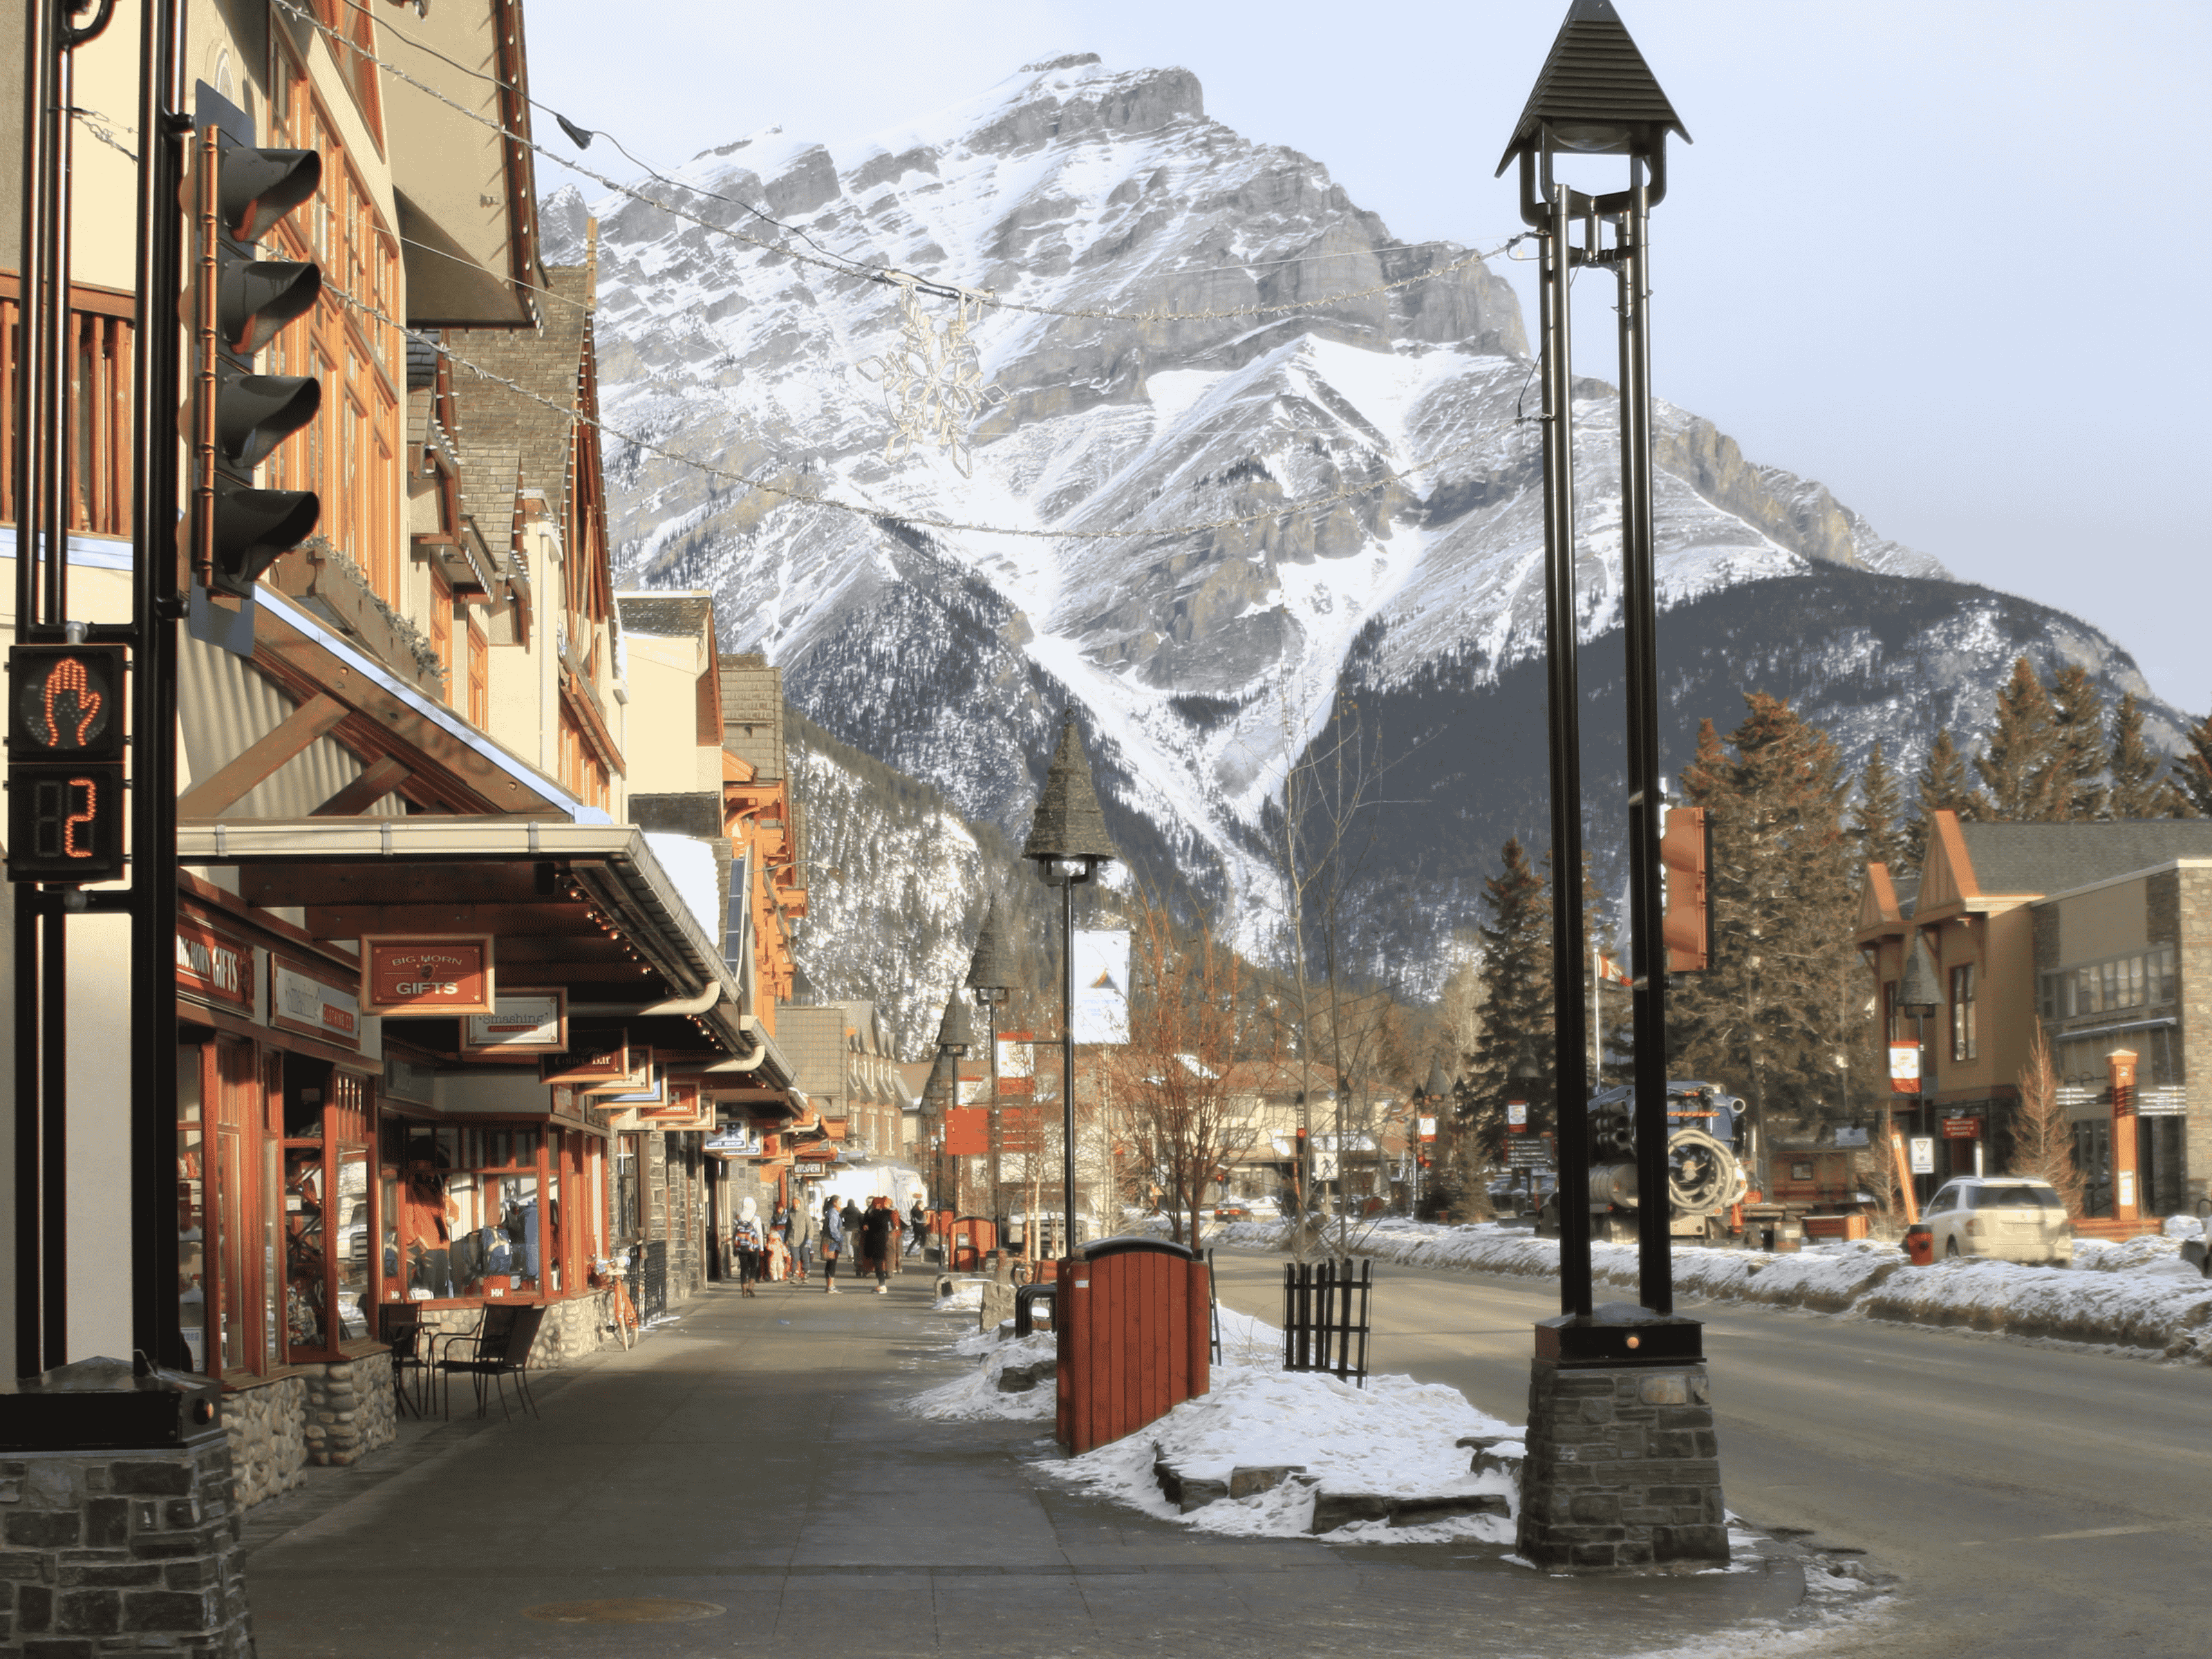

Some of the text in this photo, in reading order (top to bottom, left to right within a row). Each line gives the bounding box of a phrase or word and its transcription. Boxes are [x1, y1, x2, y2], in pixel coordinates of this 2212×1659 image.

[65, 779, 97, 857] 2
[212, 946, 238, 993] GIFTS
[392, 955, 462, 966] BIG HORN
[396, 982, 459, 995] GIFTS
